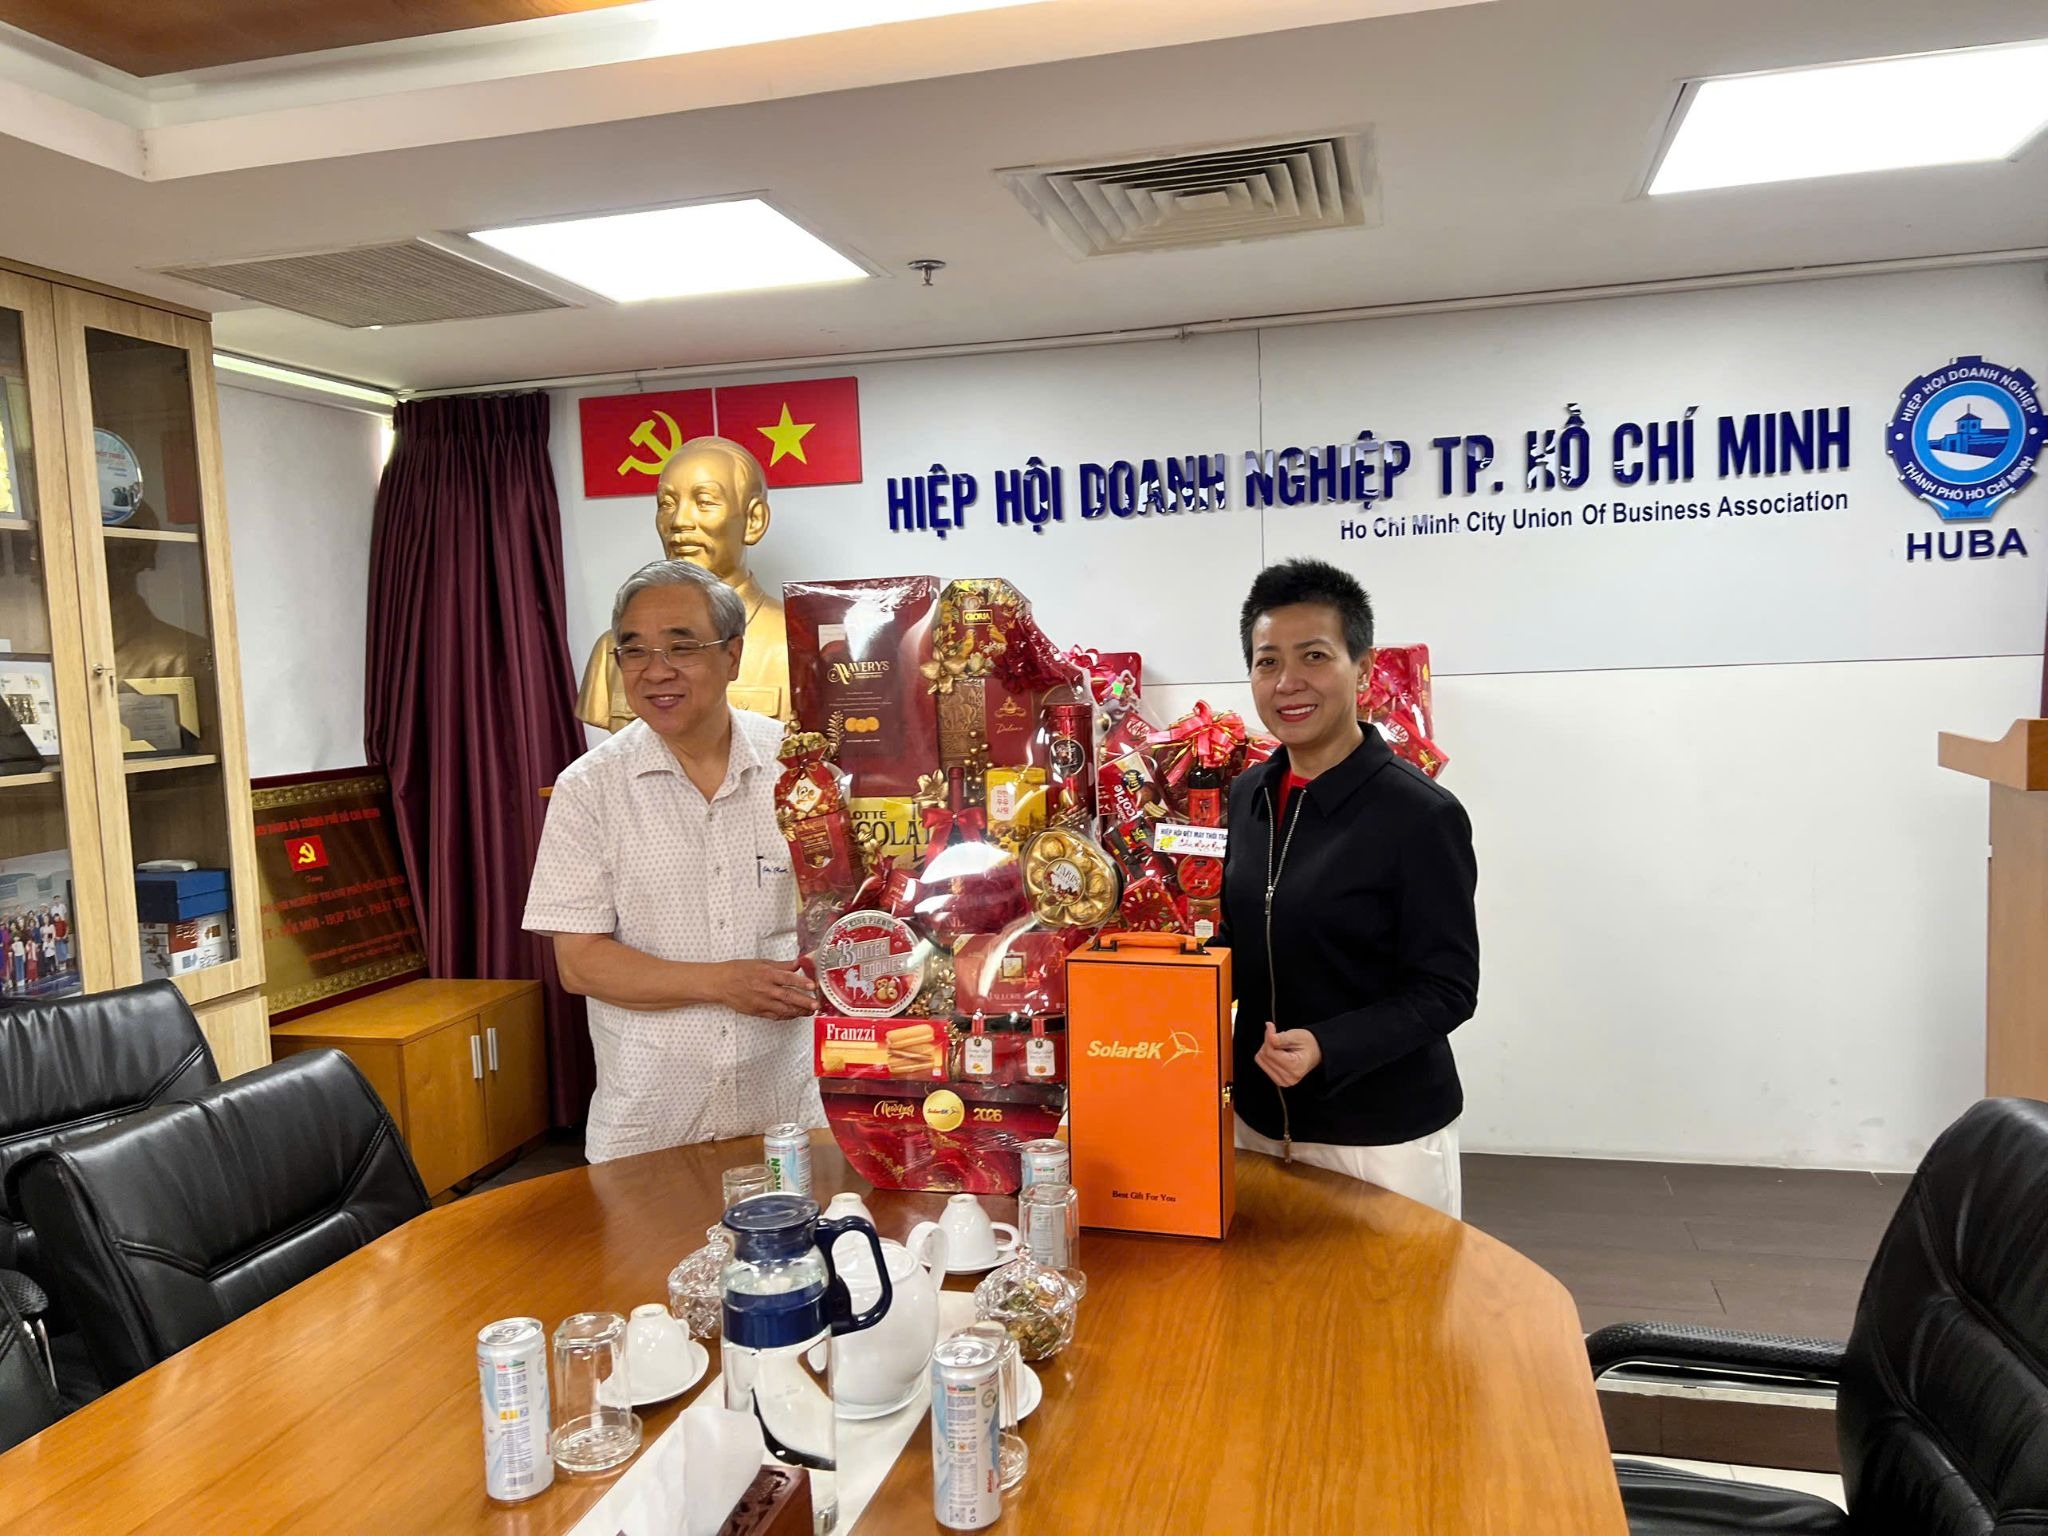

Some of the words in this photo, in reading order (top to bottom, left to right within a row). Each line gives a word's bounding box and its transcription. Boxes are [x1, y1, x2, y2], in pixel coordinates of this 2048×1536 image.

[1947, 367, 2000, 381] DOANH
[887, 463, 977, 539] HIỆP
[995, 456, 1063, 532] HỘI
[1079, 453, 1225, 519] DOANH
[1245, 430, 1411, 509] NGHIỆP
[1433, 434, 1504, 495] TP.
[1526, 402, 1590, 489] HỒ
[1613, 405, 1699, 484] CHÍ
[1718, 406, 1850, 477] MINH
[2008, 455, 2034, 487] MINH
[1341, 519, 1367, 540] Ho
[1374, 517, 1406, 538] Chi
[1412, 512, 1460, 535] Minh
[1467, 511, 1506, 536] City
[1513, 508, 1572, 529] Union
[1582, 503, 1606, 525] Of
[1613, 501, 1711, 524] Business
[1717, 491, 1848, 518] Association
[1907, 528, 2028, 561] HUBA
[850, 811, 887, 819] OTTE
[837, 938, 888, 967] BUTTER
[826, 1024, 875, 1041] Franzzi
[1087, 1040, 1164, 1060] SolarBK
[973, 1108, 1003, 1122] 2026
[1112, 1190, 1128, 1199] Best
[1130, 1191, 1144, 1200] Gift
[1145, 1193, 1158, 1201] For
[1160, 1194, 1176, 1202] You
